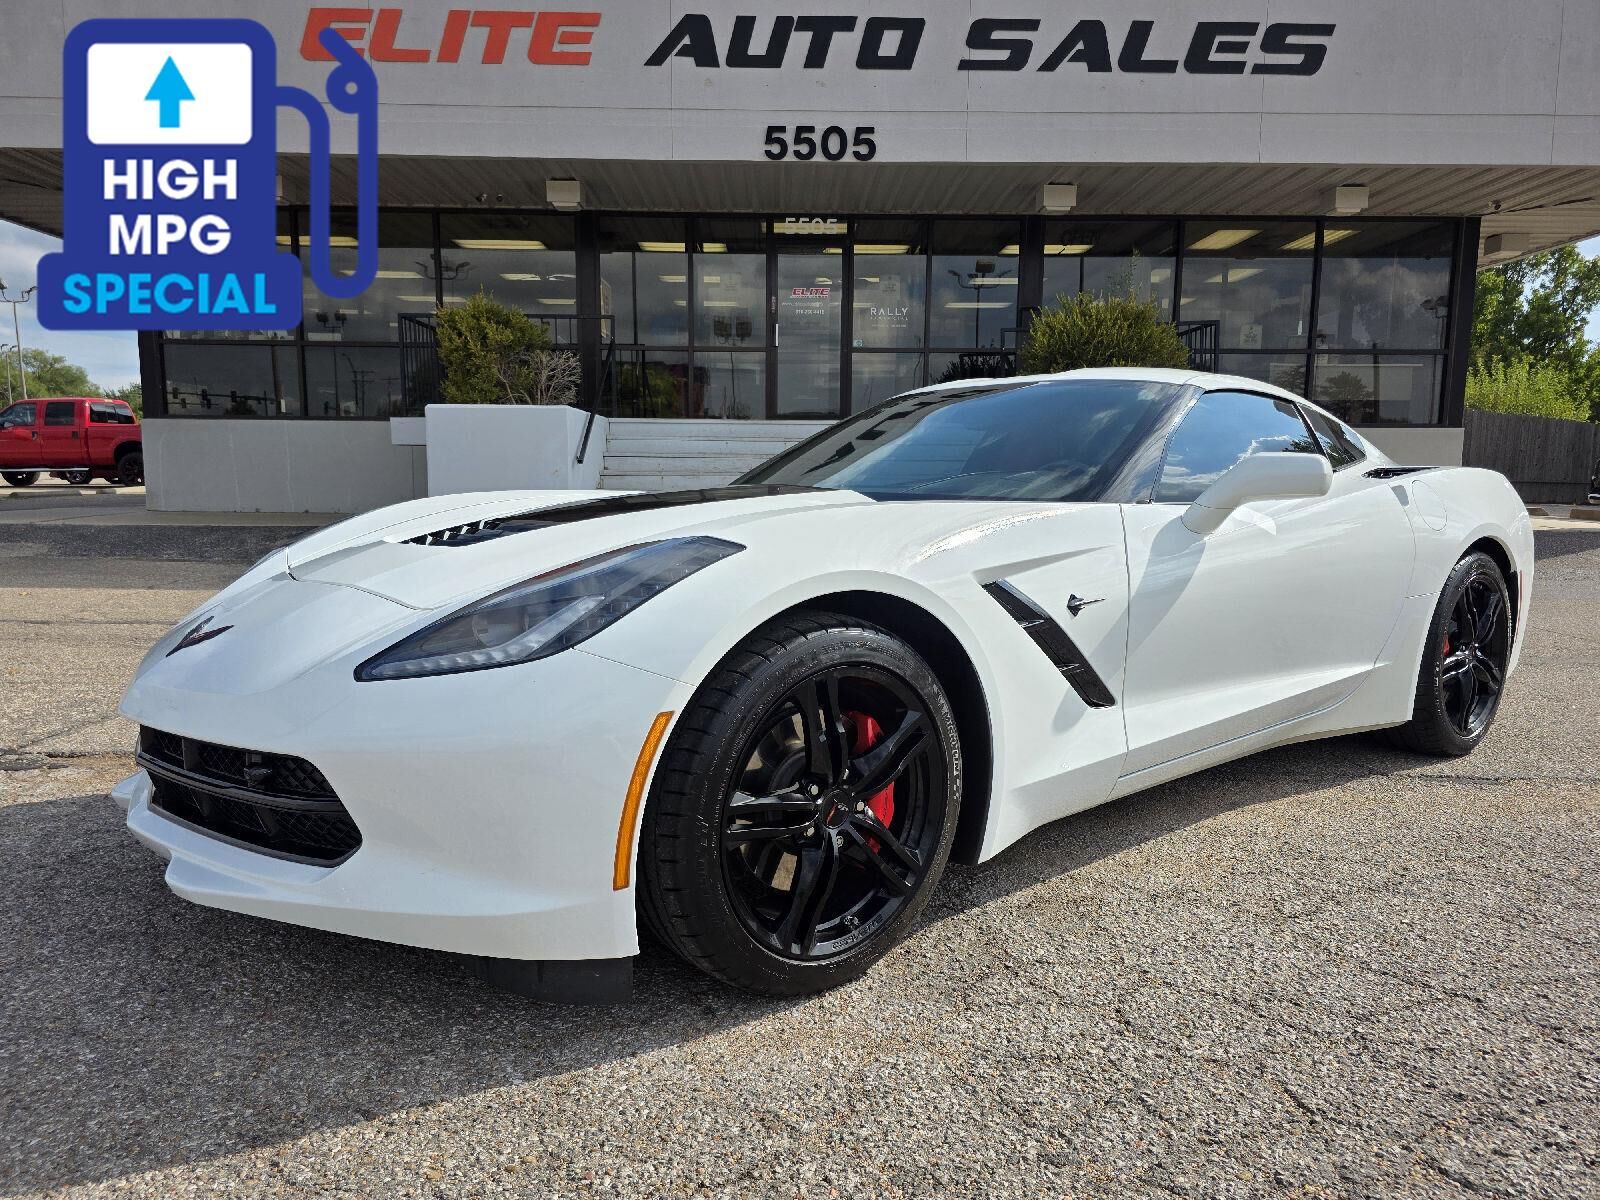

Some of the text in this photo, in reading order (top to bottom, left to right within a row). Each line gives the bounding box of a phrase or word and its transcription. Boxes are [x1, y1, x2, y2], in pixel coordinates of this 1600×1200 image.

[299, 8, 1336, 76] ELITE AUTO SALES
[764, 125, 877, 161] 5505
[791, 287, 831, 296] ELITE
[870, 307, 909, 316] RALLY
